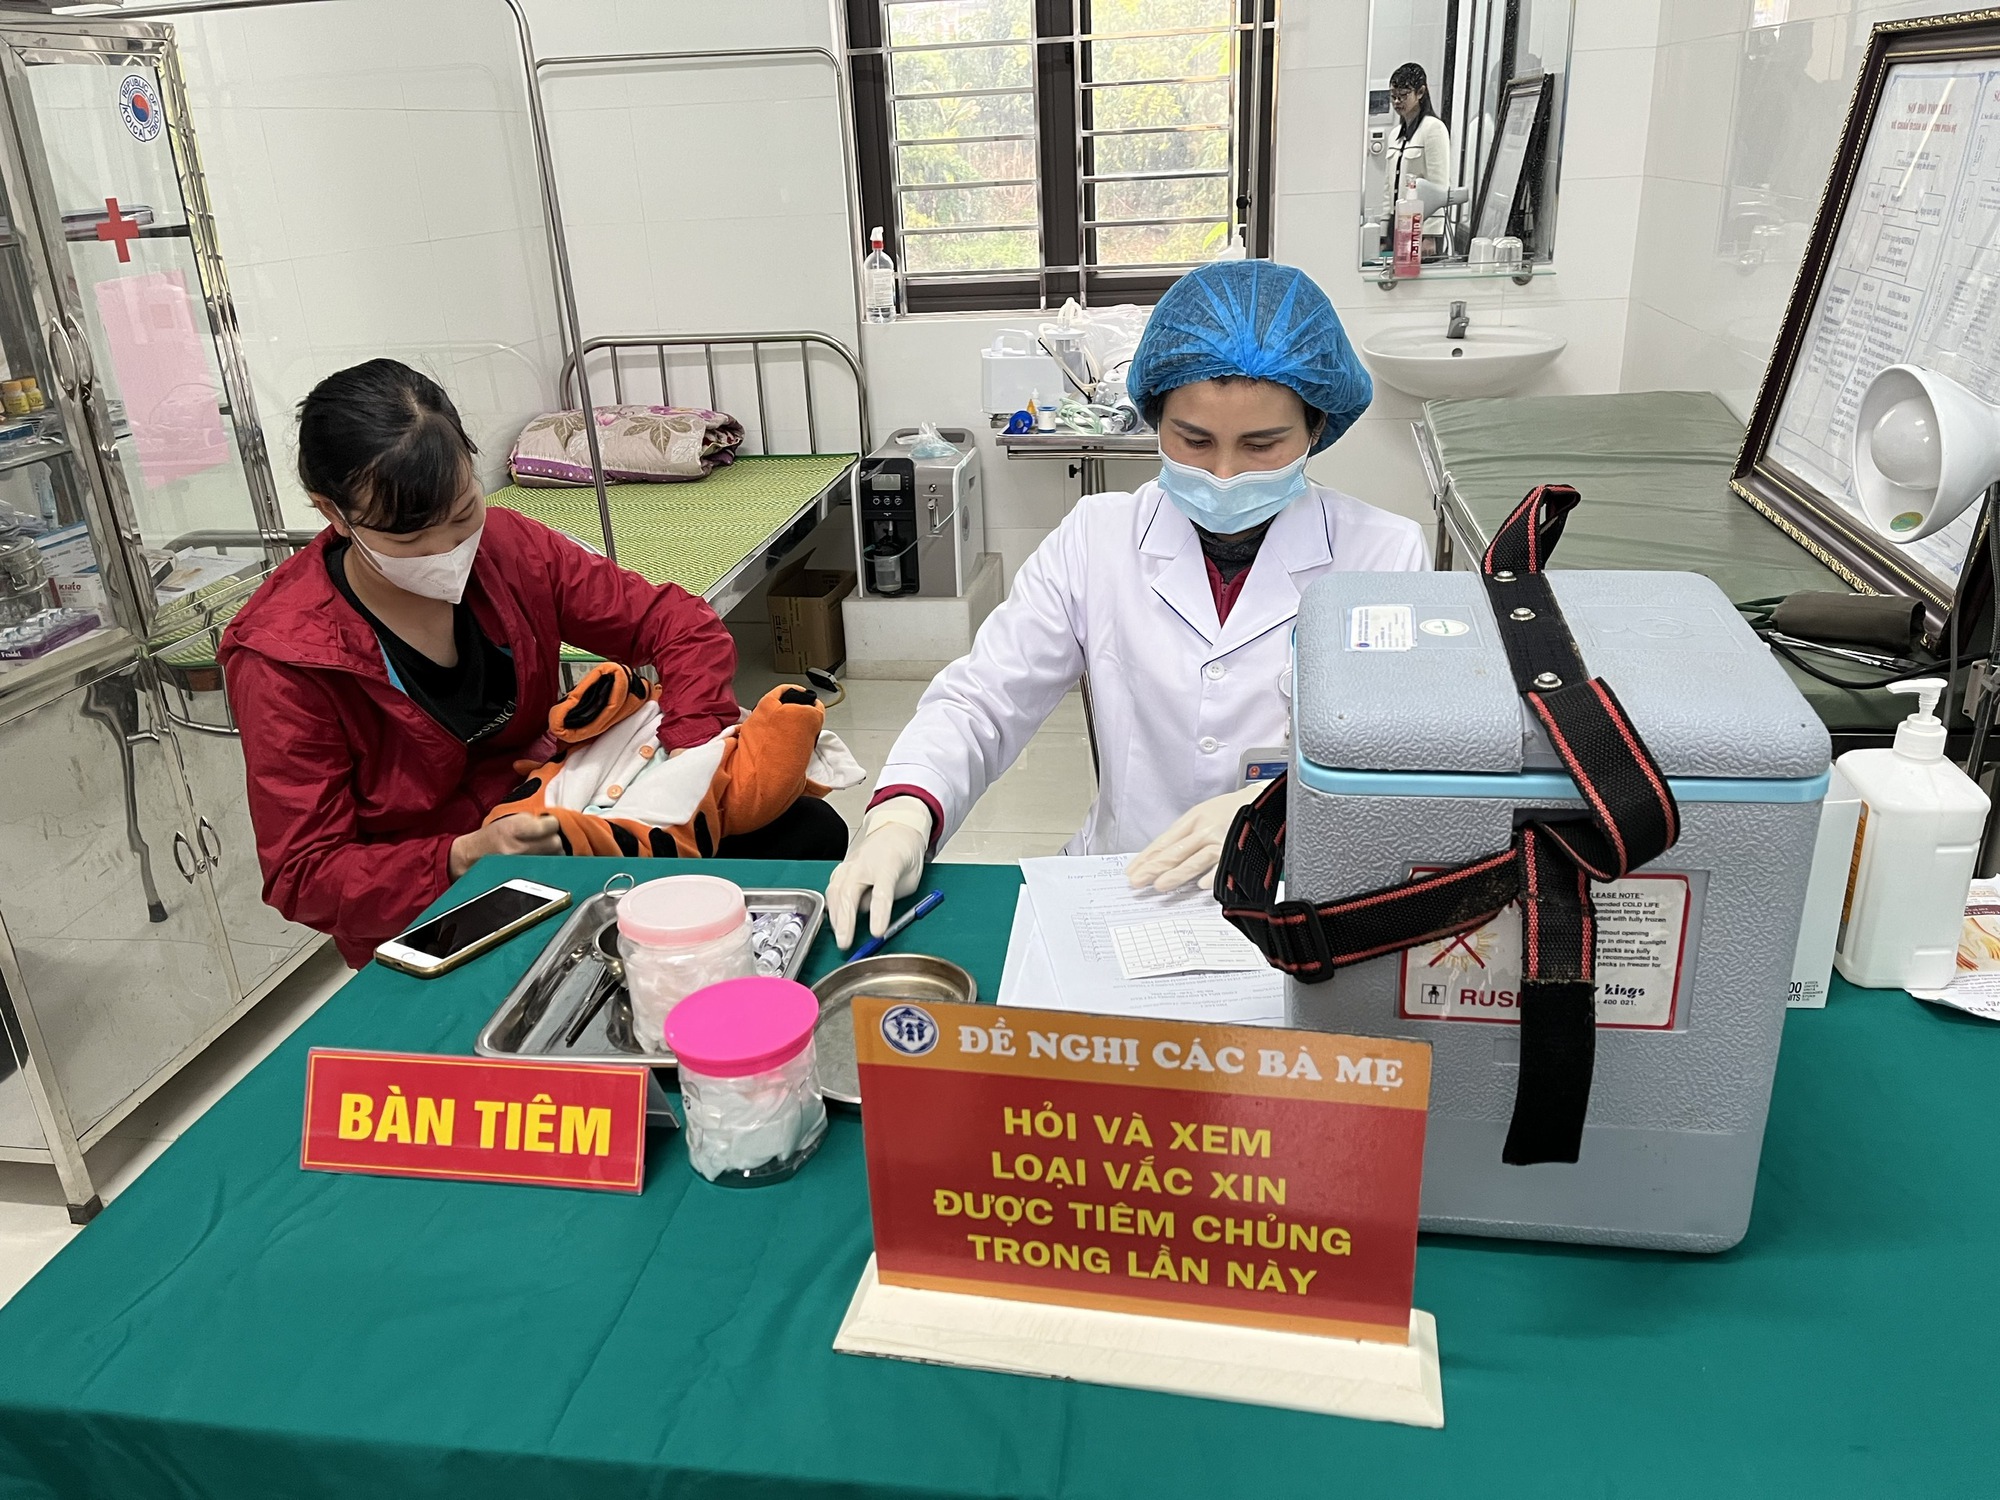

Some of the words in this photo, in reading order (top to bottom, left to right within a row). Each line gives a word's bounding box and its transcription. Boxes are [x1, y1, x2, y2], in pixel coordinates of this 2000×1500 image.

[122, 78, 149, 98] REPUBLIC
[149, 93, 158, 106] OF
[122, 107, 144, 138] KOICA
[147, 110, 160, 136] KOREA
[1628, 916, 1643, 924] fully
[1636, 947, 1651, 955] fully
[1604, 983, 1646, 1000] kings
[1789, 981, 1802, 994] 00
[958, 1017, 1016, 1056] ĐỀ
[1028, 1031, 1139, 1073] NGHỊ
[1152, 1037, 1246, 1074] CÁC
[1258, 1042, 1322, 1081] BÀ
[1335, 1054, 1403, 1092] MẸ
[338, 1085, 455, 1146] BÀN
[474, 1093, 611, 1157] TIÊM
[1004, 1101, 1077, 1141] HỎI
[1093, 1105, 1153, 1148] VÀ
[1169, 1122, 1271, 1158] XEM
[992, 1152, 1086, 1187] LOẠI
[1103, 1155, 1193, 1196] VẮC
[1209, 1173, 1286, 1205] XIN
[933, 1189, 1053, 1227] ĐƯỢC
[1068, 1199, 1175, 1239] TIÊM
[1192, 1212, 1351, 1256] CHỦNG
[967, 1234, 1111, 1275] TRONG
[1127, 1243, 1209, 1284] LẦN
[1227, 1256, 1317, 1295] NÀY
